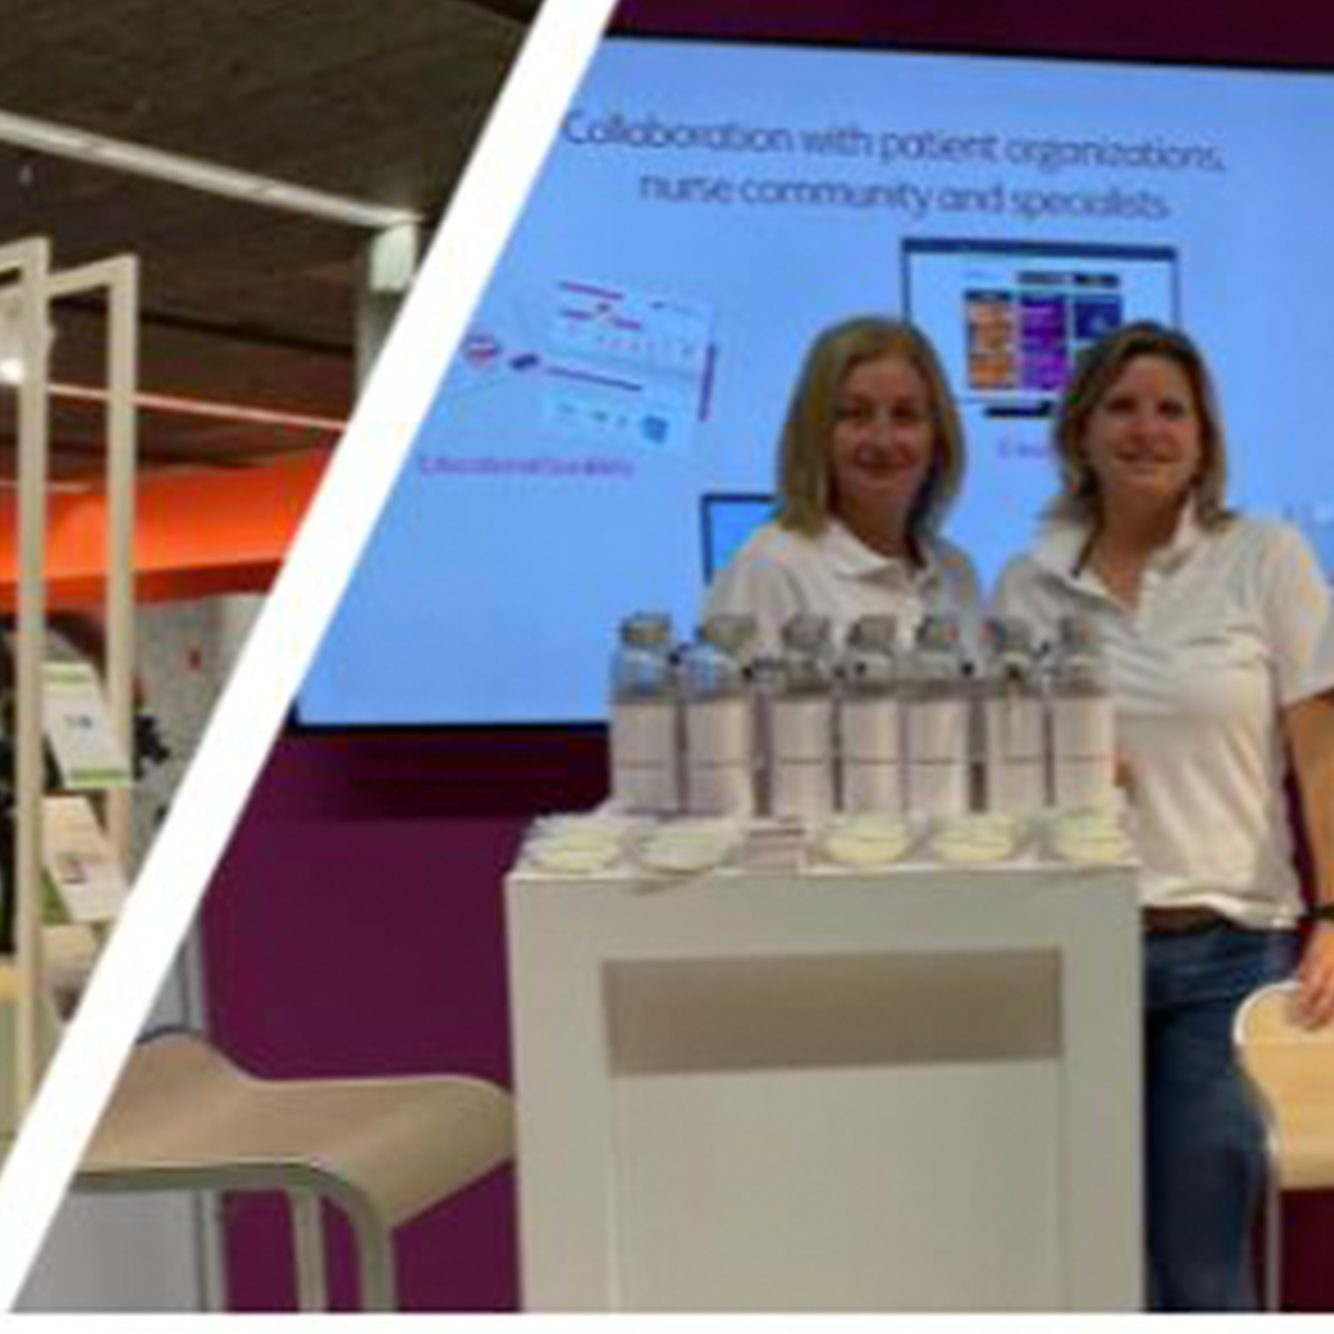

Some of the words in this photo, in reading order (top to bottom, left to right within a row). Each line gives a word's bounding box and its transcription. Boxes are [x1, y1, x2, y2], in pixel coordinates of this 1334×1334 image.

[564, 110, 794, 154] Collaboration
[799, 121, 873, 155] with
[880, 127, 1001, 168] patient
[639, 175, 733, 202] nurse
[740, 178, 930, 221] community
[936, 182, 1005, 213] and
